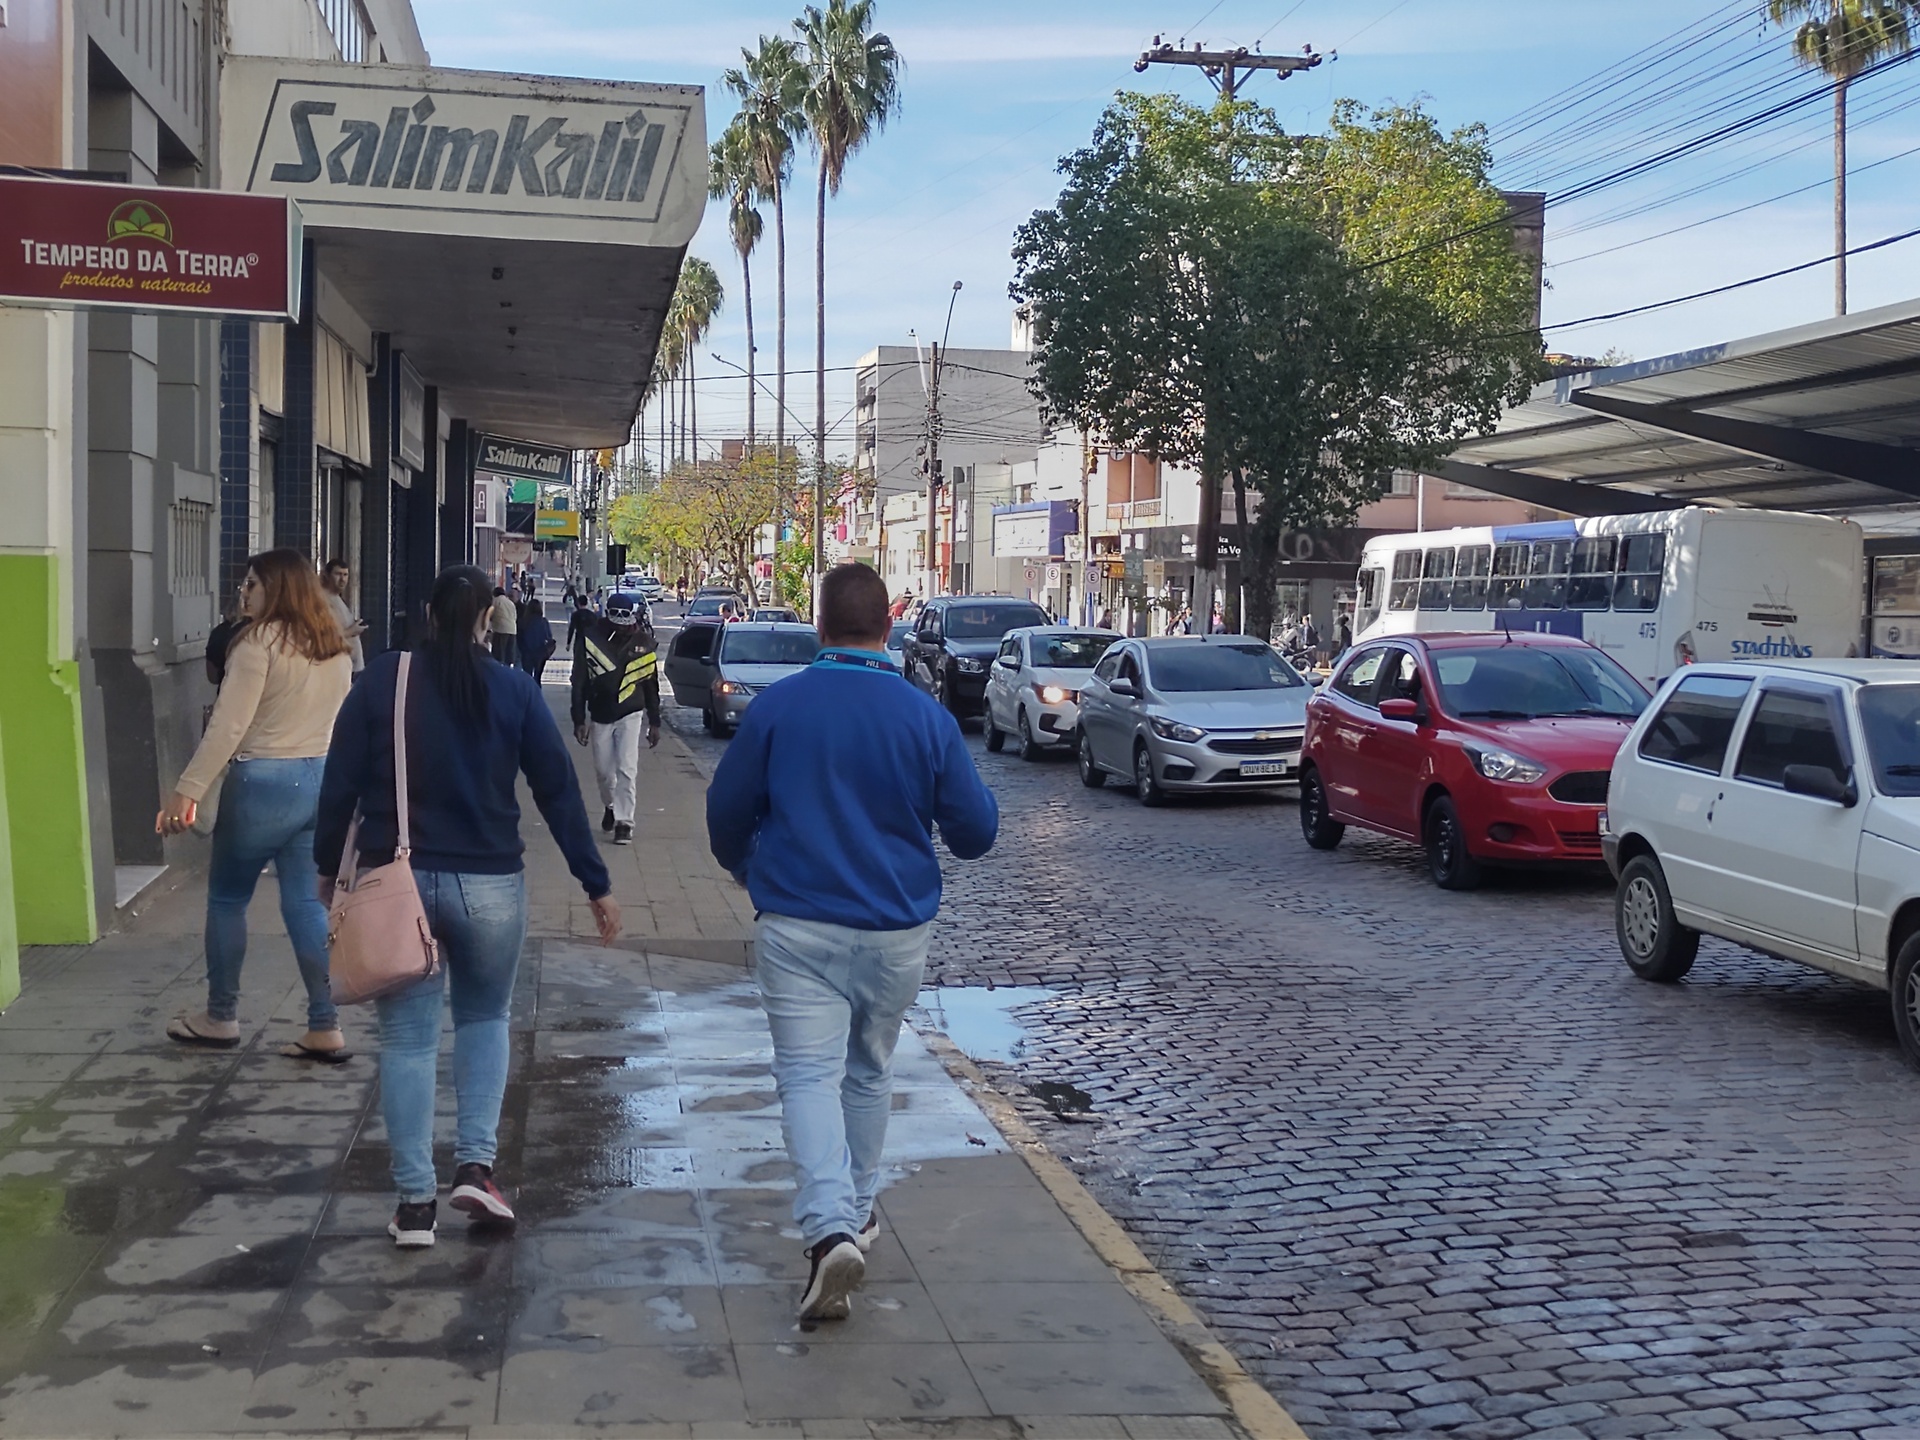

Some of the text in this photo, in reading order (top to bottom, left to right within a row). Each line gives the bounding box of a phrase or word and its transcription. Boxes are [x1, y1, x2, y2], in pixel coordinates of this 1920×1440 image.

[20, 238, 129, 270] TEMPERO
[137, 249, 169, 274] DA
[59, 270, 213, 295] produtos naturais
[1638, 622, 1657, 639] 475
[1695, 621, 1719, 633] 475
